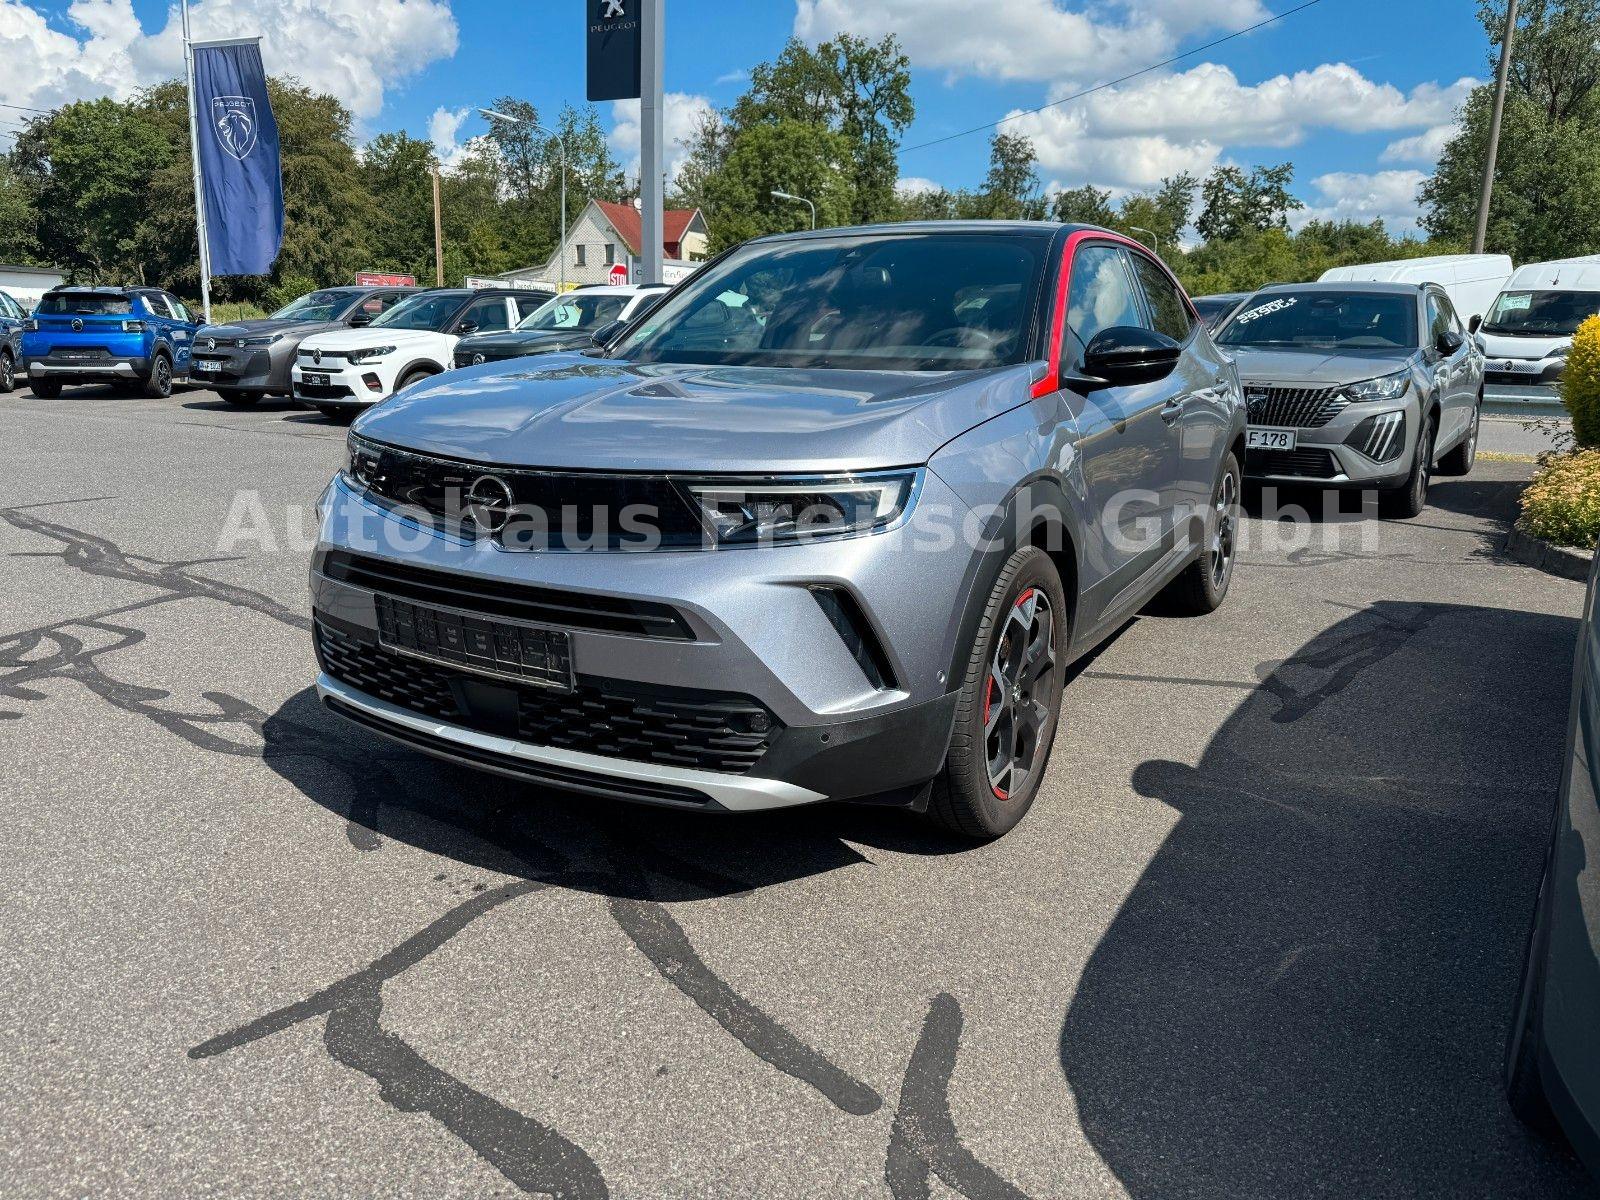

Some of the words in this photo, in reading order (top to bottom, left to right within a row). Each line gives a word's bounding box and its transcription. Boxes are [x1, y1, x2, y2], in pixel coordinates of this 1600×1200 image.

[590, 21, 636, 33] PEUGEOT
[1248, 431, 1259, 445] F
[1260, 432, 1288, 447] 178
